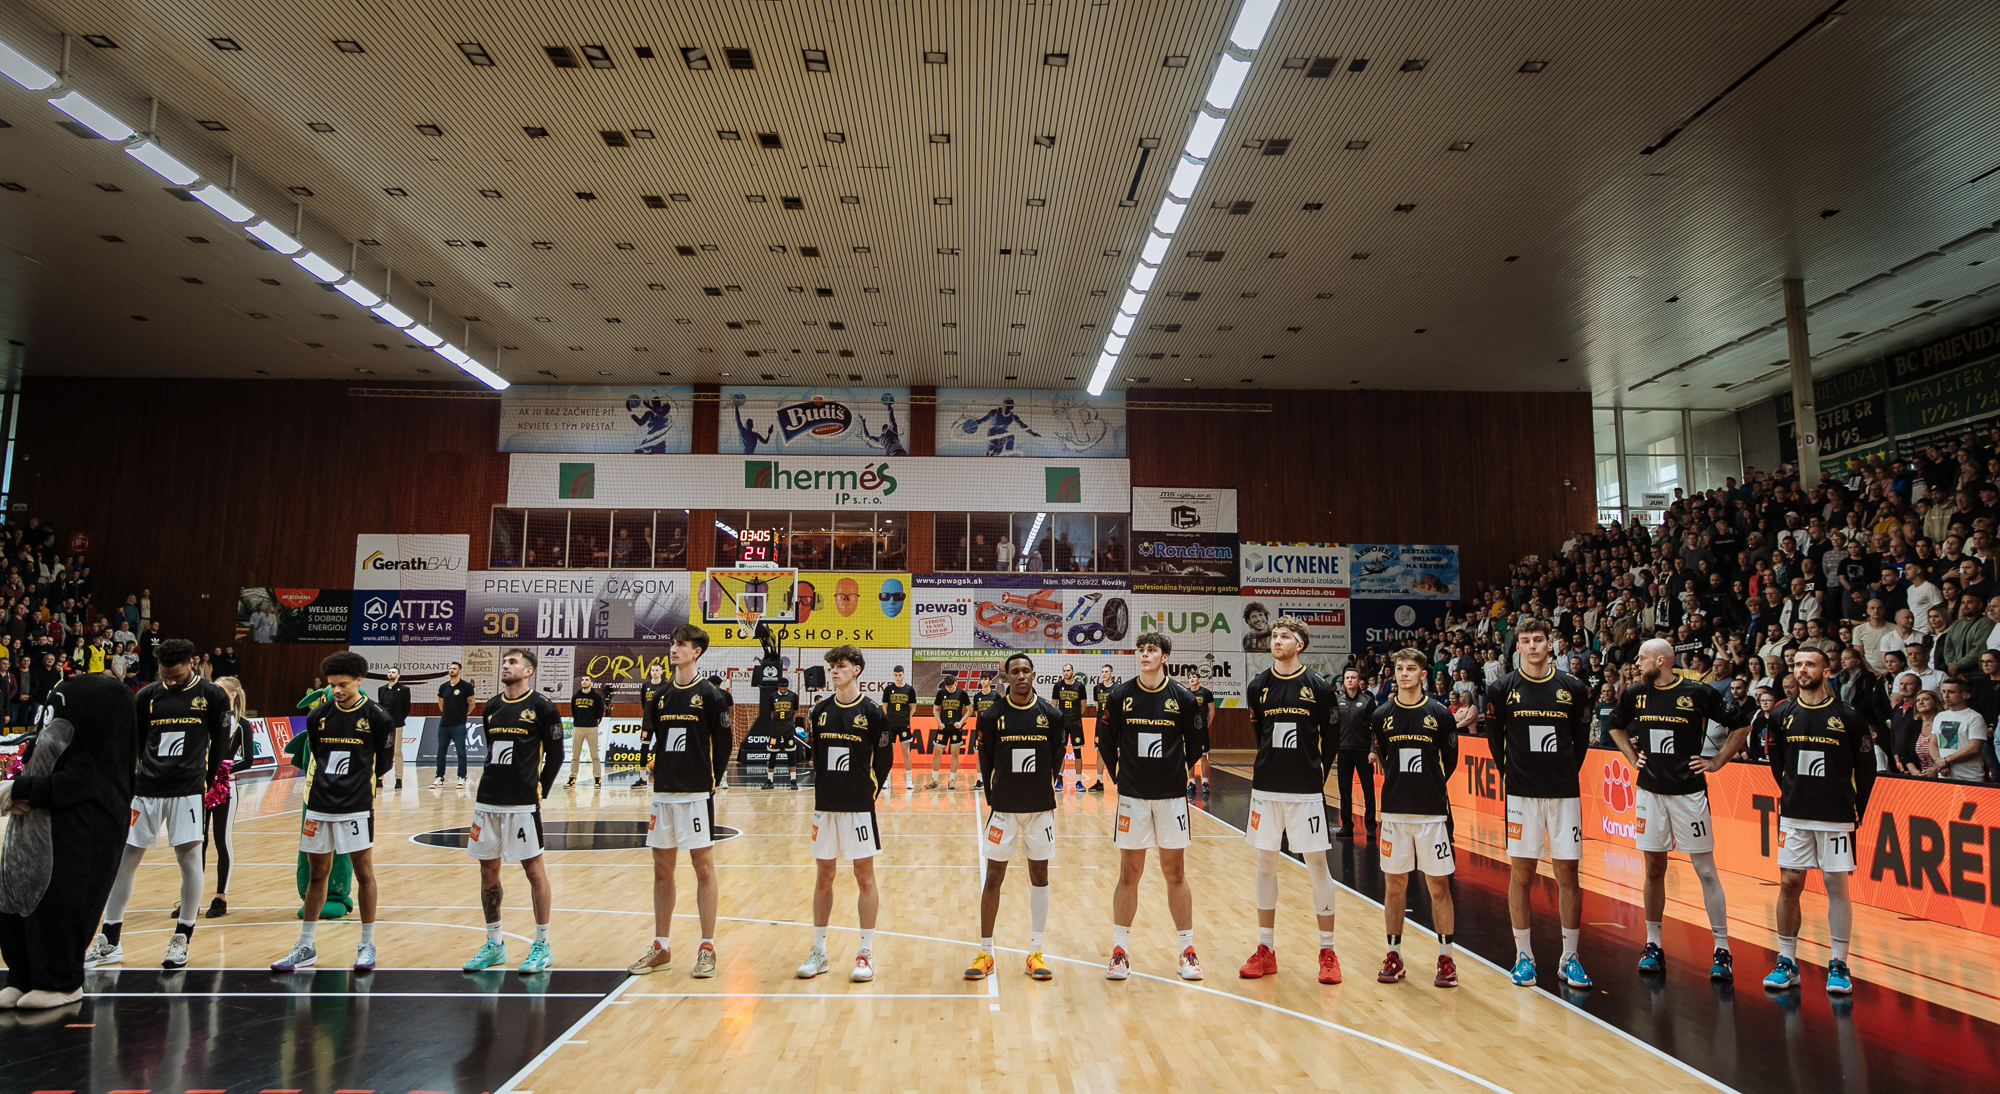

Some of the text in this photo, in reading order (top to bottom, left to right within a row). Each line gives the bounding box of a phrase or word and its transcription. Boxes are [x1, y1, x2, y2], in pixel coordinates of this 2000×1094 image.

[1813, 366, 1878, 402] RIEVIDZA
[518, 408, 530, 416] AK
[532, 408, 542, 416] JU
[544, 408, 561, 416] RAZ
[562, 406, 600, 416] ZAČNETE
[517, 422, 551, 430] NEVIETE
[562, 420, 577, 430] TÝM
[786, 406, 846, 431] Budiš
[835, 493, 850, 505] IP
[743, 546, 766, 560] 24
[1154, 542, 1232, 559] Ronchem
[1354, 546, 1400, 561] AEROREST
[1267, 555, 1339, 574] ICYNENE
[484, 576, 674, 594] PREVERENÉ ČASOM
[916, 577, 983, 586] www.pewagsk.sk
[1101, 578, 1127, 587] Nováky
[1246, 576, 1281, 584] Kanadská
[1282, 576, 1315, 584] striekaná
[1133, 584, 1177, 592] profesionálna
[1254, 588, 1336, 596] www.izolacia.eu
[388, 600, 454, 619] ATTIS
[915, 603, 967, 616] pewag
[483, 613, 519, 635] 30
[536, 598, 610, 639] BENY stav
[1141, 611, 1231, 634] NUPA
[308, 623, 347, 631] ENERGIOU
[363, 622, 452, 631] SPORTSWEAR
[545, 648, 564, 656] AJ
[586, 654, 673, 680] ORVA
[1064, 701, 1072, 709] 21
[1635, 694, 1647, 709] 31
[947, 710, 953, 718] 9
[1263, 707, 1310, 717] PRIEVIDZA
[1513, 710, 1568, 719] PRIEVIDZA
[150, 717, 202, 726] PRIEVIDZA
[1126, 718, 1175, 727] PRIEVIDZA
[1639, 715, 1689, 724] PRIEVIDZA
[820, 733, 862, 742] PRIEVIDZA
[1389, 734, 1433, 743] PRIEVIDZA
[1786, 735, 1840, 746] PRIEVIDZA
[613, 753, 641, 761] 0908
[350, 820, 359, 836] 3
[693, 817, 701, 832] 6
[1307, 815, 1320, 834] 17
[1690, 820, 1707, 838] 31
[517, 827, 527, 843] 4
[855, 825, 869, 842] 10
[1434, 841, 1451, 860] 22
[1829, 835, 1848, 855] 77
